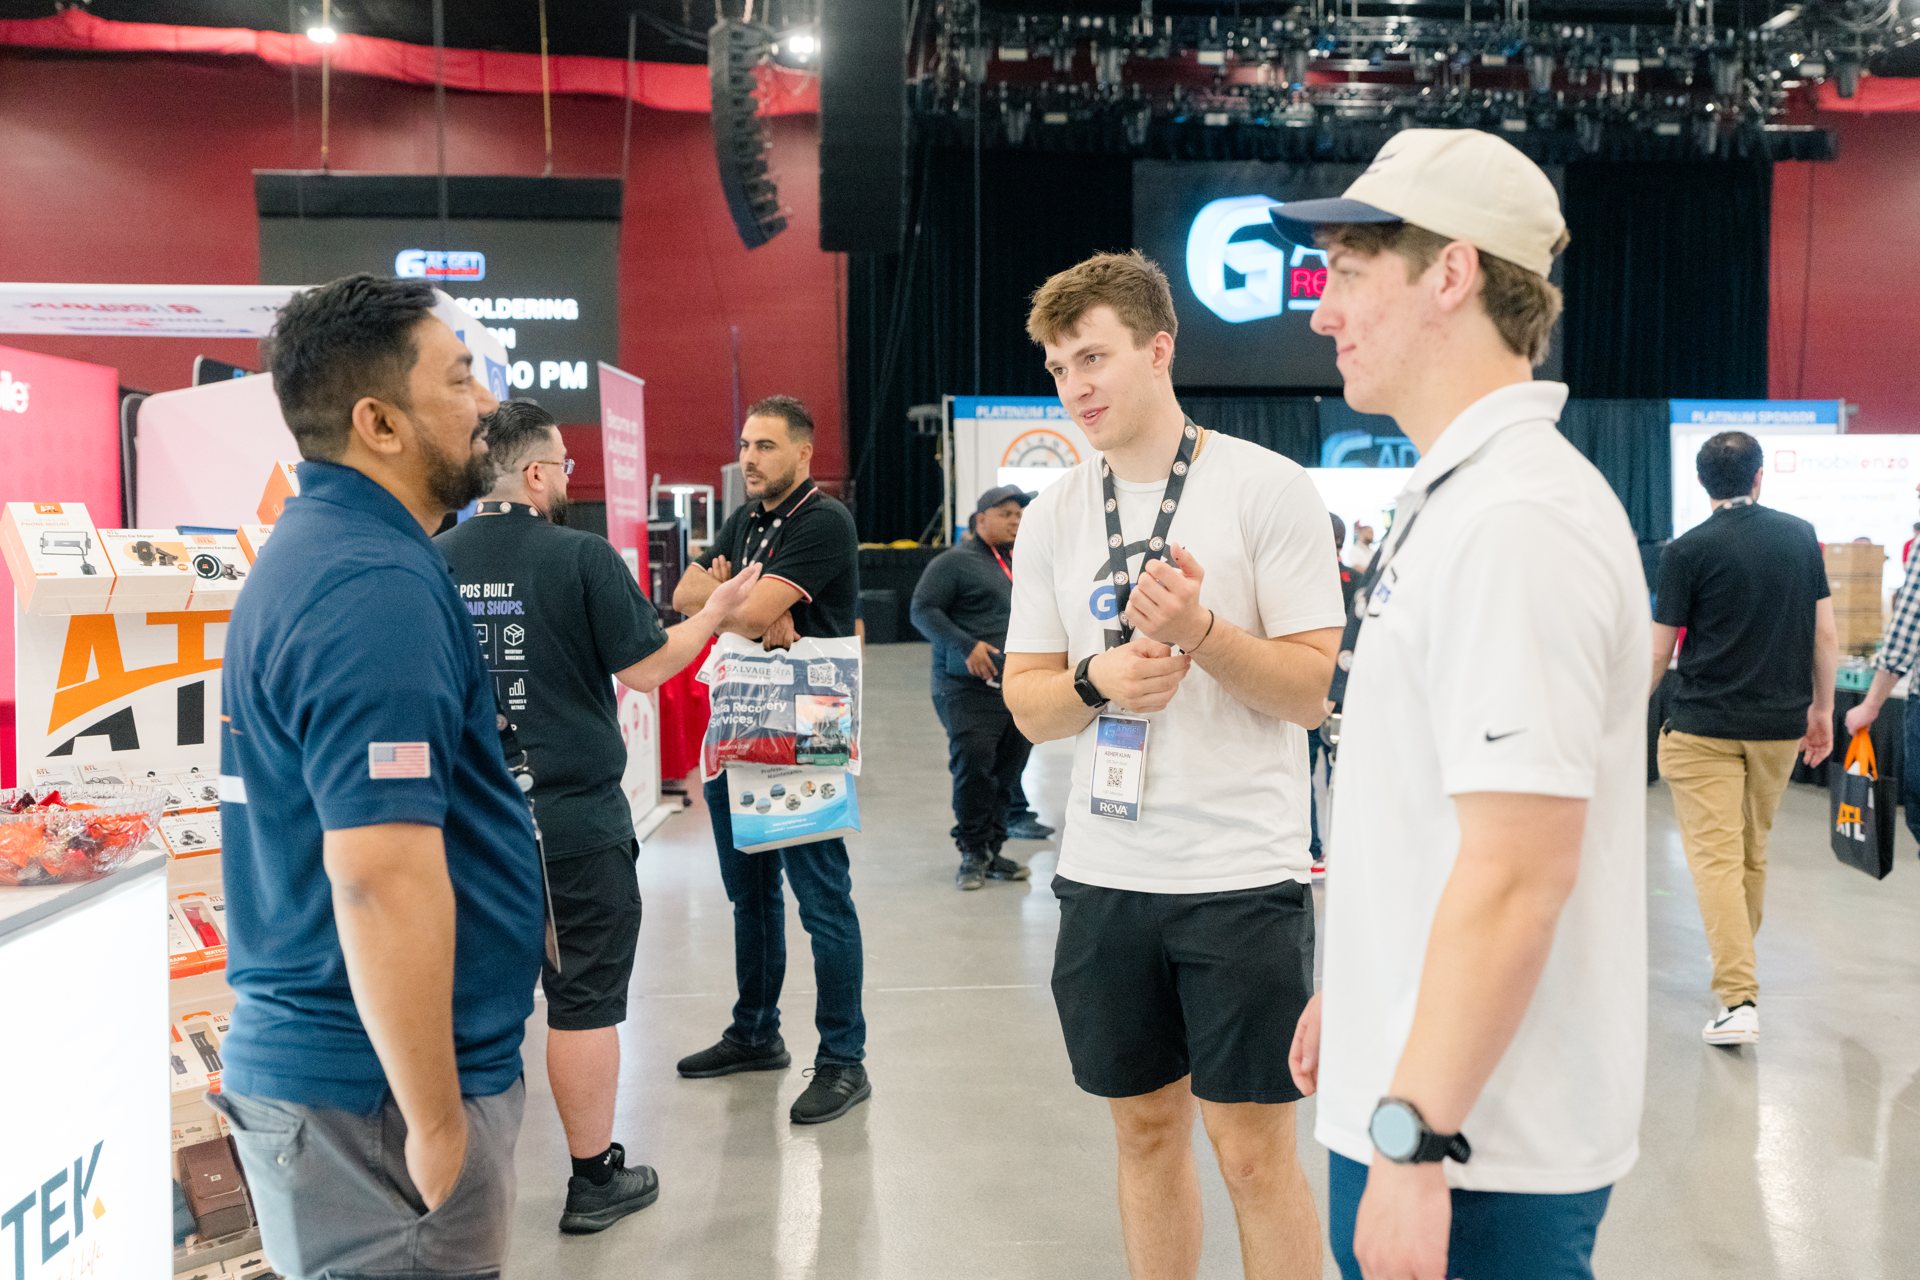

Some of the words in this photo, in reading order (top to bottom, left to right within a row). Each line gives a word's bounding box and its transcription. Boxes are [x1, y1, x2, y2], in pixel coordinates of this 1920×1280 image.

[455, 298, 580, 321] SOLDERING
[540, 360, 588, 390] PM
[975, 405, 1044, 418] PLATINUM
[1691, 411, 1756, 423] PLATINUM
[1758, 411, 1817, 423] SPONSOR
[459, 583, 481, 599] POS
[483, 583, 515, 598] BUILT
[486, 600, 526, 616] SHOPS.
